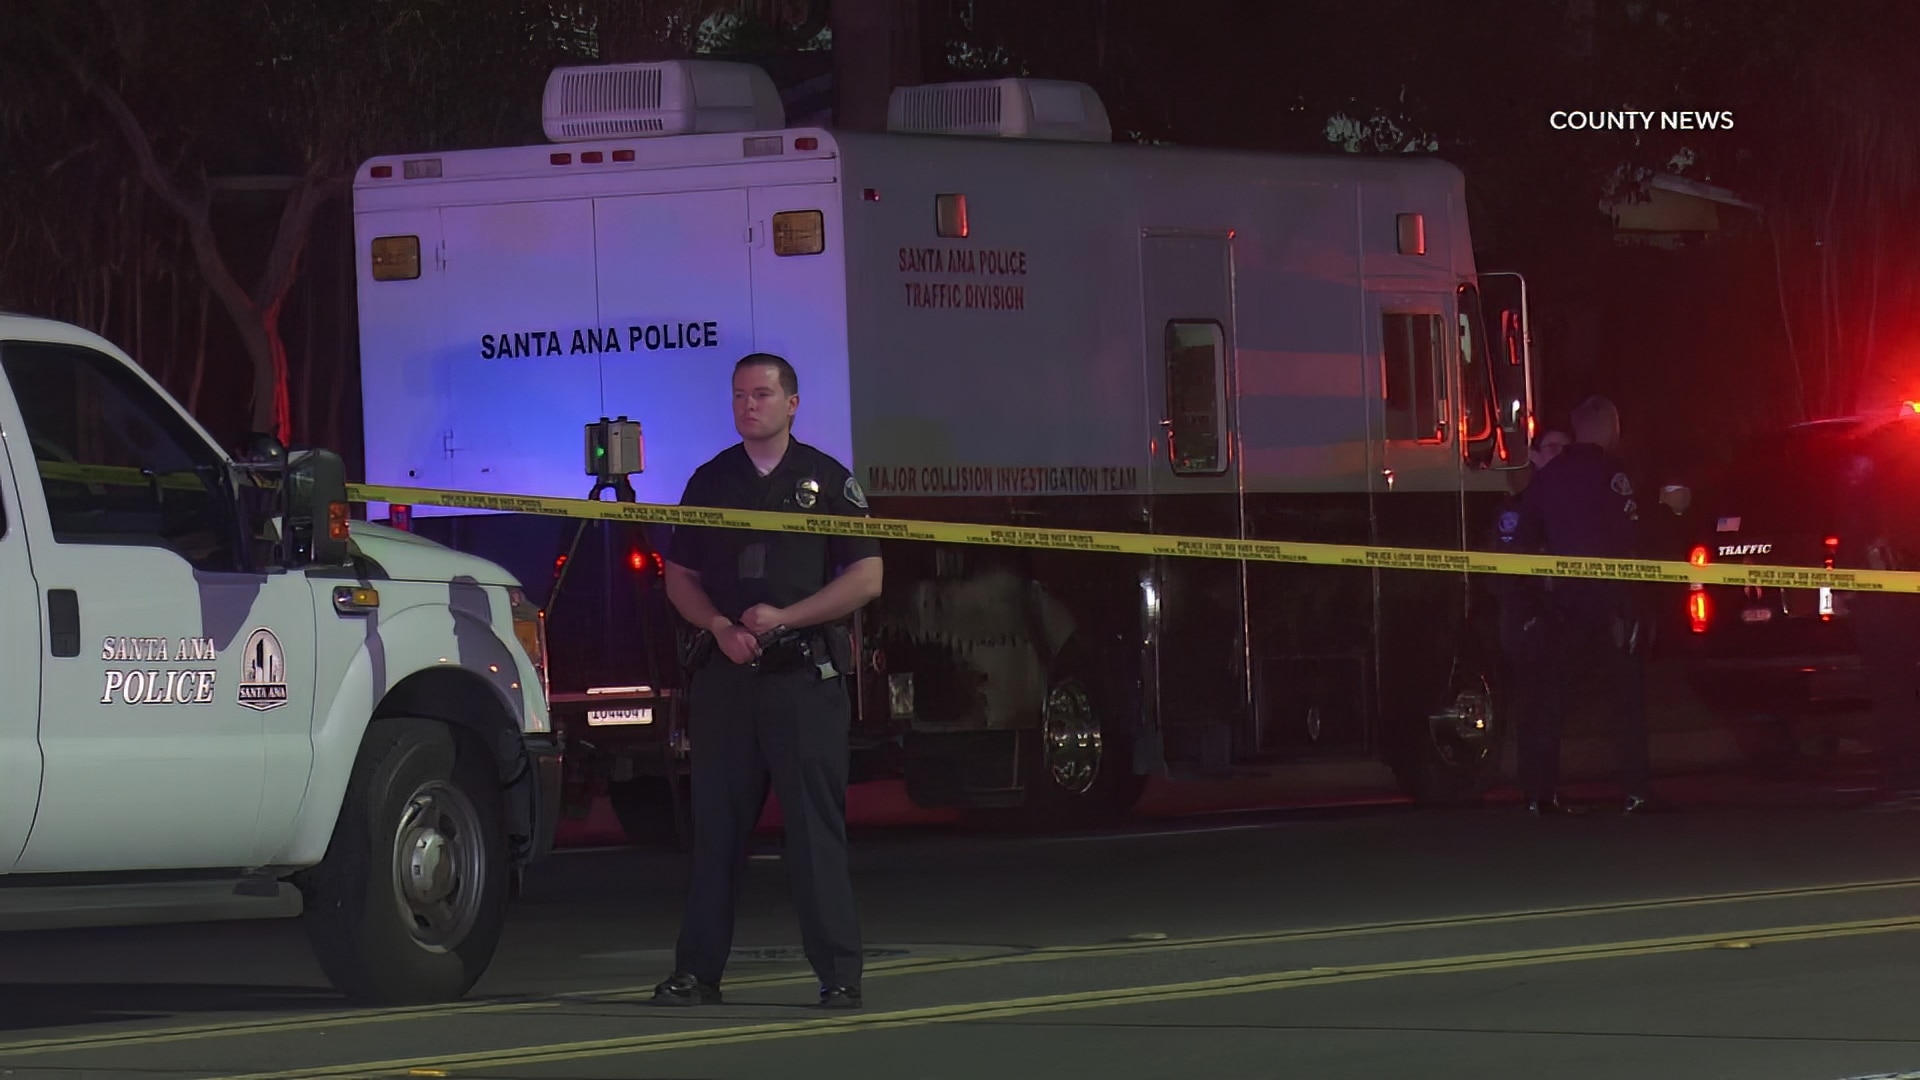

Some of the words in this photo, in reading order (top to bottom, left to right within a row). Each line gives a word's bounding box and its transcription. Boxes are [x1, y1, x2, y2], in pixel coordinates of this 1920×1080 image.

[899, 248, 943, 273] SANTA
[948, 250, 975, 274] ANA
[979, 251, 1027, 275] POLICE
[905, 283, 961, 309] TRAFFIC
[965, 284, 1024, 311] DIVISION
[481, 331, 562, 360] SANTA
[570, 327, 621, 355] ANA
[629, 321, 718, 352] POLICE
[869, 466, 917, 491] MAJOR
[921, 467, 993, 492] COLLISION
[999, 467, 1098, 492] INVESTIGATION
[1103, 467, 1137, 491] TEAM
[1718, 544, 1772, 556] TRAFFIC
[102, 636, 168, 661] SANTA
[174, 637, 216, 661] ANA
[101, 670, 216, 704] POLICE
[240, 687, 266, 697] SANTA
[268, 687, 285, 697] ANA
